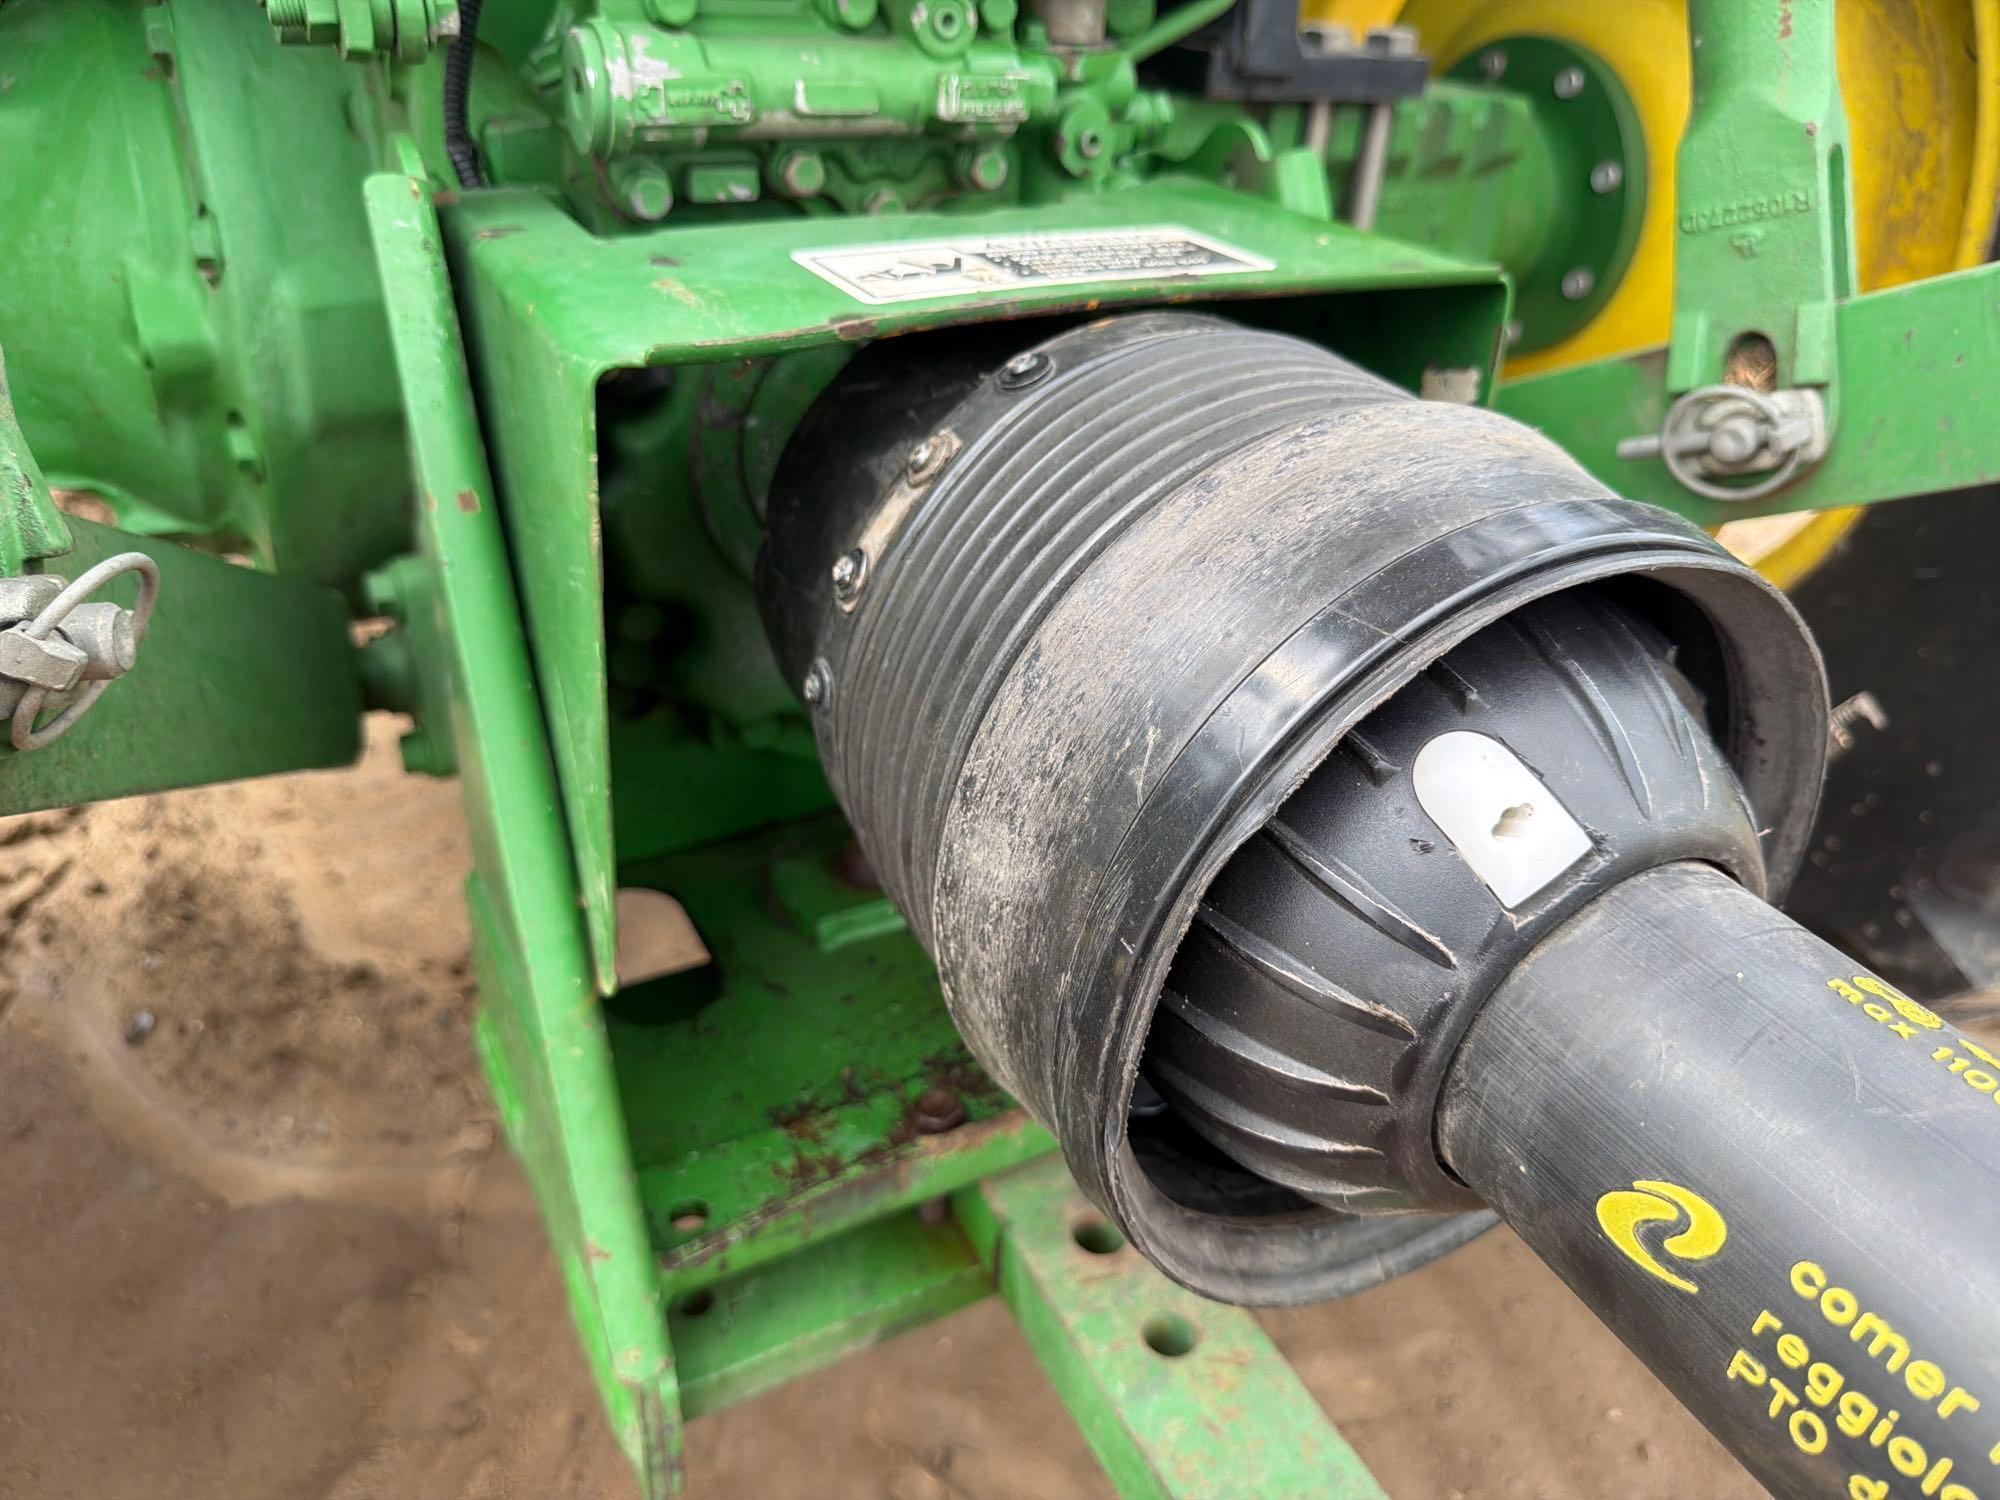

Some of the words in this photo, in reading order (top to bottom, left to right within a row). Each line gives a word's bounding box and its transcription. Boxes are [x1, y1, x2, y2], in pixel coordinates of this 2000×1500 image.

[1827, 979, 1918, 1039] max
[1790, 1260, 1979, 1420] comer
[1726, 1349, 1829, 1456] PTO
